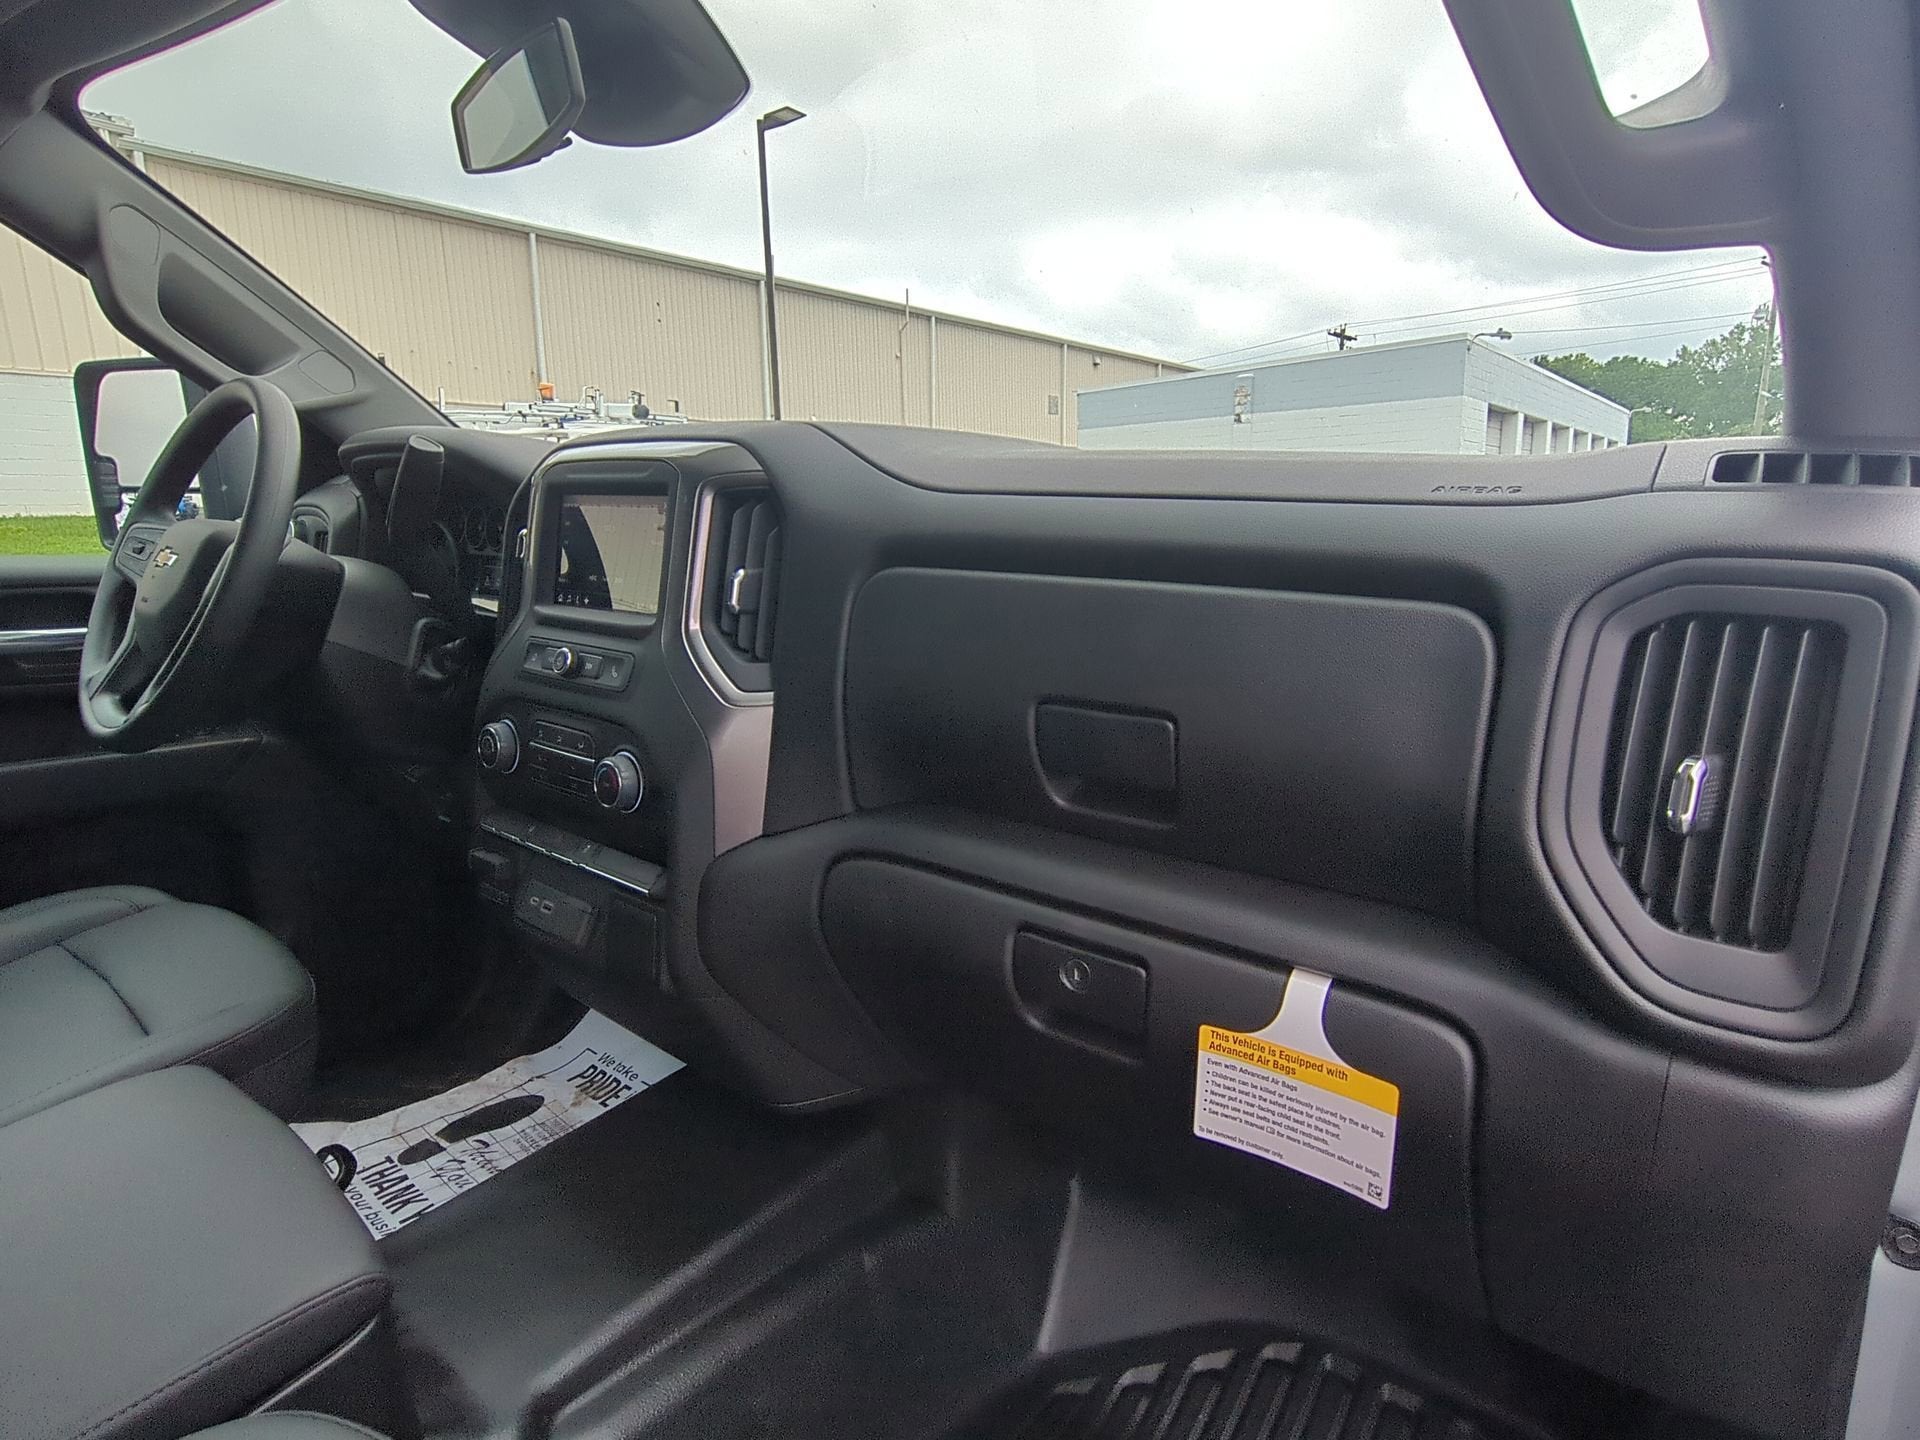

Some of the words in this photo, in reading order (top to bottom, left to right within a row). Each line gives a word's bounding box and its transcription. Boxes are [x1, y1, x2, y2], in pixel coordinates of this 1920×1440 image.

[597, 1052, 616, 1068] We
[613, 1061, 639, 1082] take
[1207, 1058, 1222, 1066] Even
[1224, 1063, 1237, 1072] with
[1239, 1067, 1269, 1081] Advanced
[1271, 1077, 1280, 1085] Air
[1282, 1081, 1298, 1092] Bags
[1209, 1041, 1254, 1061] Advanced
[1256, 1055, 1270, 1066] Air
[1272, 1060, 1296, 1075] Bags
[1210, 1030, 1229, 1042] This
[1232, 1036, 1265, 1053] Vehicle
[1268, 1046, 1276, 1057] is
[1279, 1050, 1323, 1072] Equipped
[1326, 1068, 1348, 1081] with
[566, 1064, 633, 1108] PRIDE
[1211, 1080, 1221, 1088] The
[1223, 1083, 1236, 1092] back
[1238, 1088, 1250, 1096] seat
[1258, 1094, 1267, 1103] the
[1288, 1105, 1304, 1116] place
[1305, 1111, 1313, 1119] for
[1315, 1116, 1341, 1130] children.
[1212, 1071, 1236, 1083] Children
[1251, 1082, 1258, 1090] be
[1260, 1086, 1276, 1096] killed
[1286, 1095, 1313, 1110] seriously
[1316, 1105, 1338, 1118] injured
[1340, 1114, 1347, 1123] by
[1349, 1118, 1359, 1126] the
[1361, 1123, 1369, 1131] air
[1371, 1127, 1386, 1138] bag.
[1209, 1099, 1229, 1110] Always
[1242, 1109, 1254, 1118] seat
[1272, 1119, 1282, 1128] and
[1284, 1124, 1298, 1134] child
[1210, 1090, 1226, 1100] Never
[1228, 1095, 1237, 1103] put
[1277, 1111, 1291, 1121] child
[1292, 1117, 1305, 1126] seat
[1314, 1125, 1323, 1134] the
[1244, 1119, 1265, 1131] manual
[1276, 1130, 1285, 1138] for
[1302, 1141, 1336, 1158] information
[1337, 1155, 1354, 1166] about
[1356, 1163, 1364, 1171] air
[346, 1186, 373, 1212] your
[356, 1155, 429, 1215] THANK
